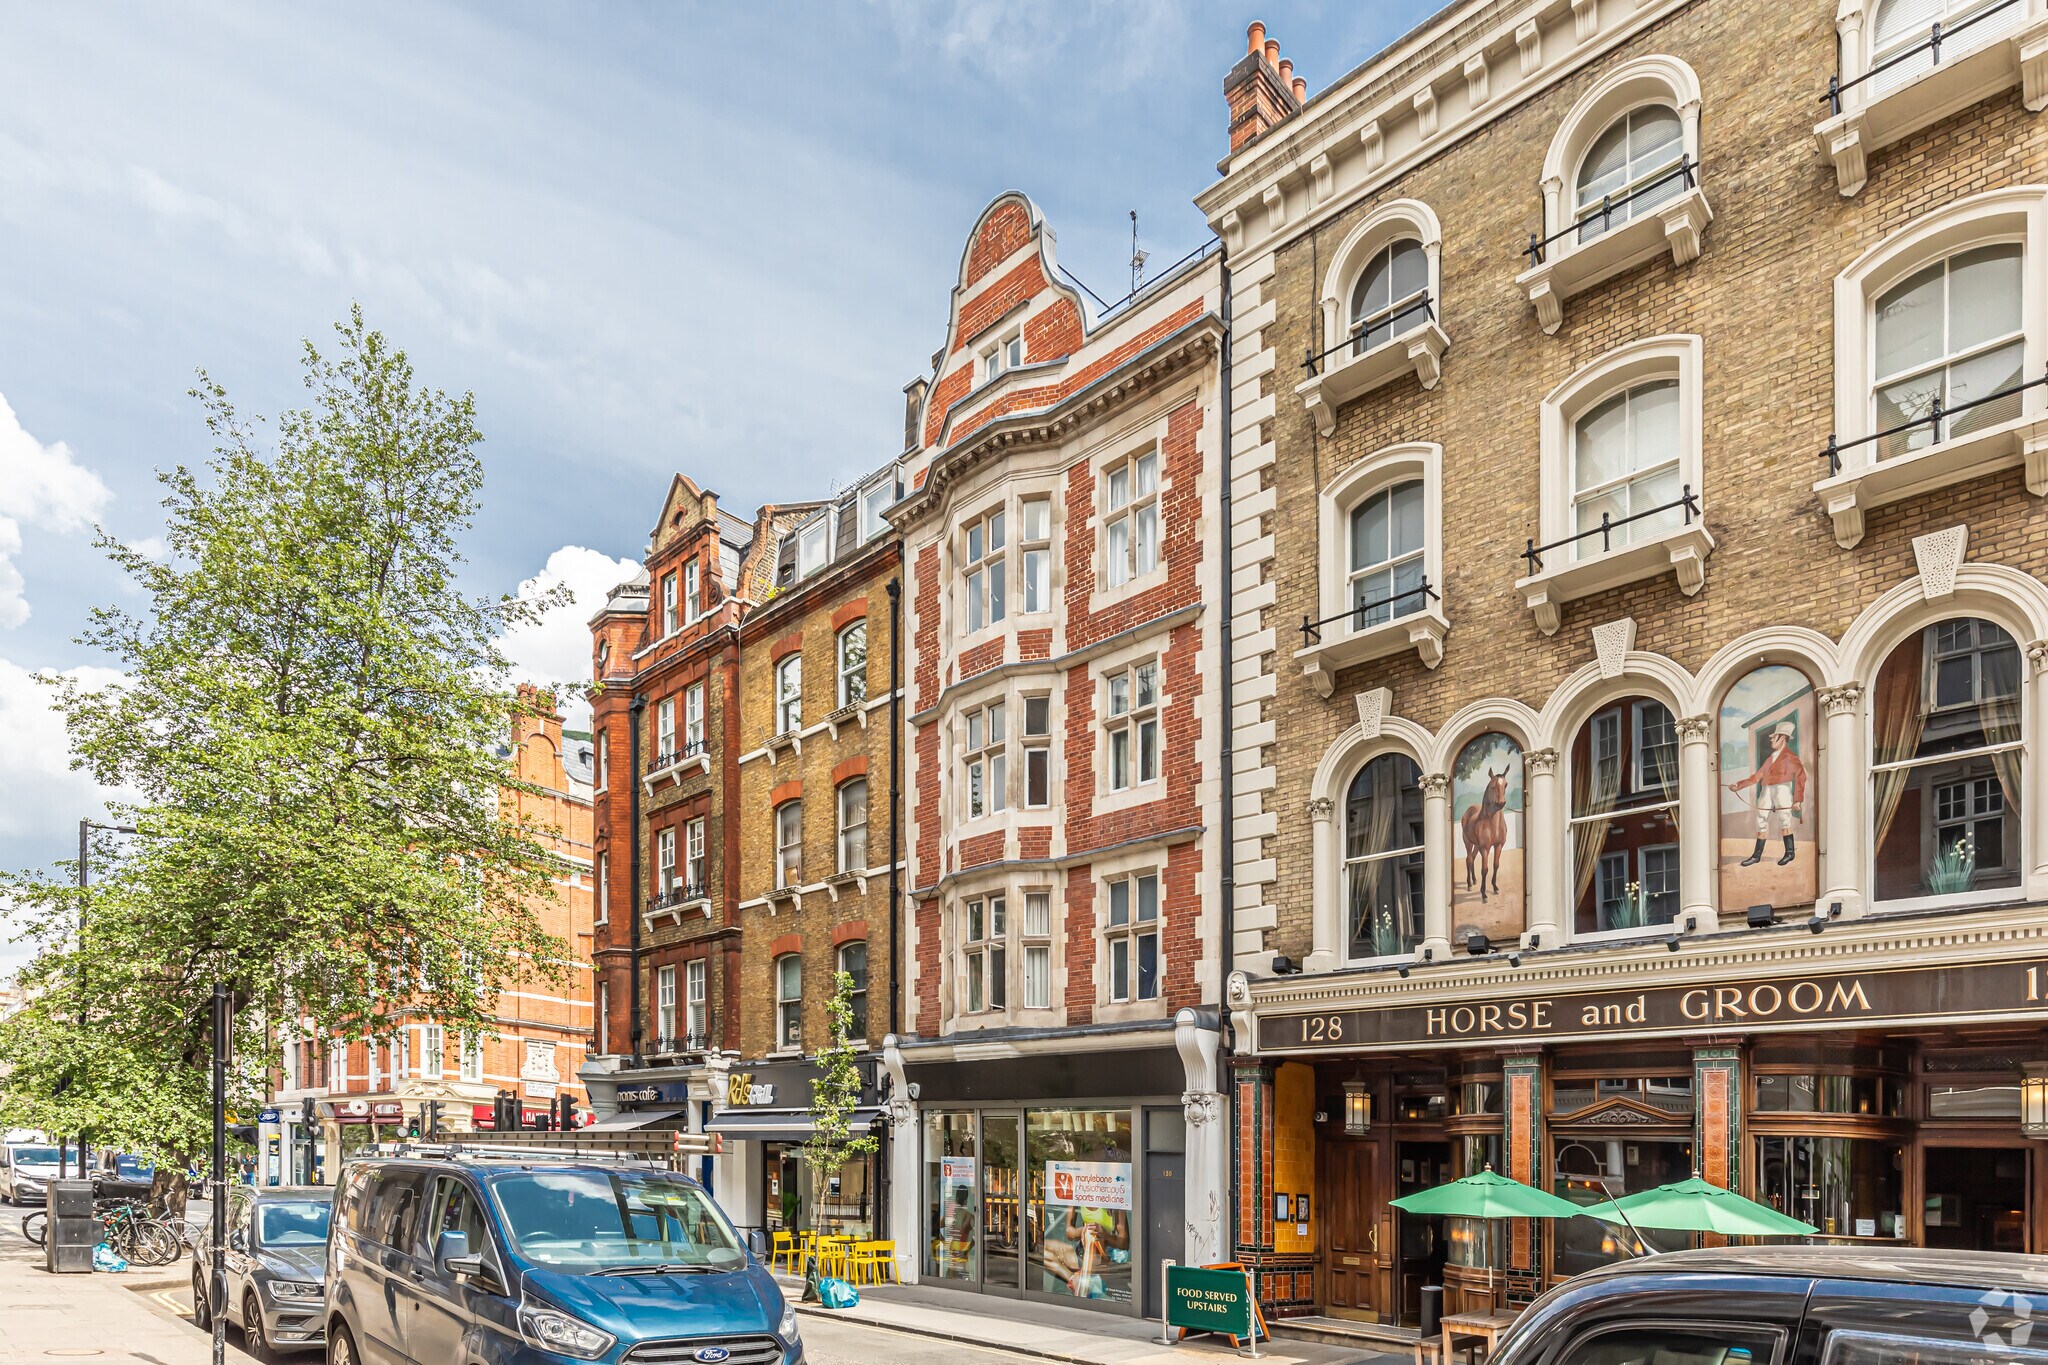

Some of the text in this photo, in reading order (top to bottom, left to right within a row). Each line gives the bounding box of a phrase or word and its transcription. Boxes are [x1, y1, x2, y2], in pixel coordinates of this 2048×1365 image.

[2026, 966, 2048, 1001] 1
[1302, 979, 1872, 1042] 128 HORSE and GROOM
[1075, 1174, 1112, 1184] marylebone
[1075, 1193, 1125, 1204] sports medicine
[1177, 1288, 1238, 1303] FOOD SERVED
[1187, 1300, 1228, 1314] UPSTAIRS
[704, 1350, 723, 1359] Ford
